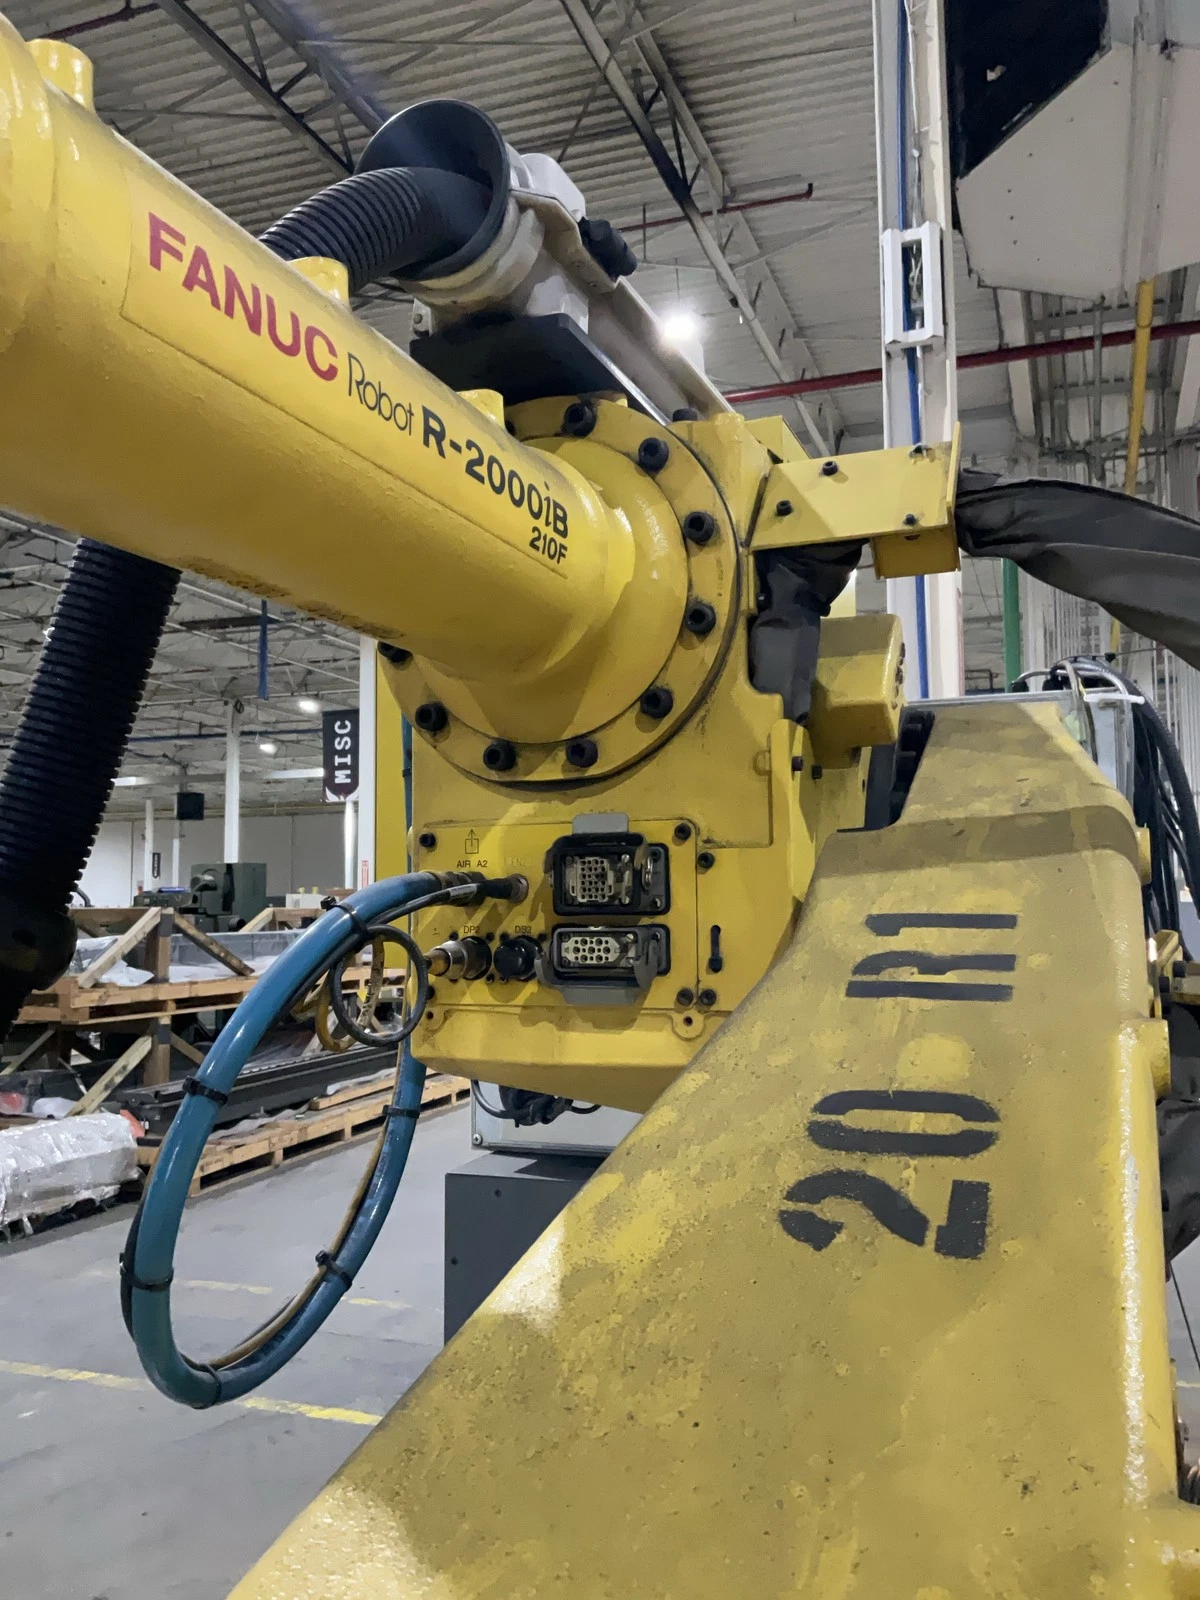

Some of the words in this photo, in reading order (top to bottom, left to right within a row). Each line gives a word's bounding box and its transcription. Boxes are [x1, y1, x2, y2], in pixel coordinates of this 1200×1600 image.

[148, 212, 338, 382] FANUC
[347, 352, 415, 436] Robot
[422, 405, 568, 539] R-2000iB
[529, 526, 568, 564] 210F
[334, 719, 351, 784] MISC
[456, 859, 471, 869] AIR
[476, 859, 488, 868] A2
[463, 925, 480, 934] DP2
[514, 925, 532, 934] DS2
[778, 1090, 1001, 1260] 20
